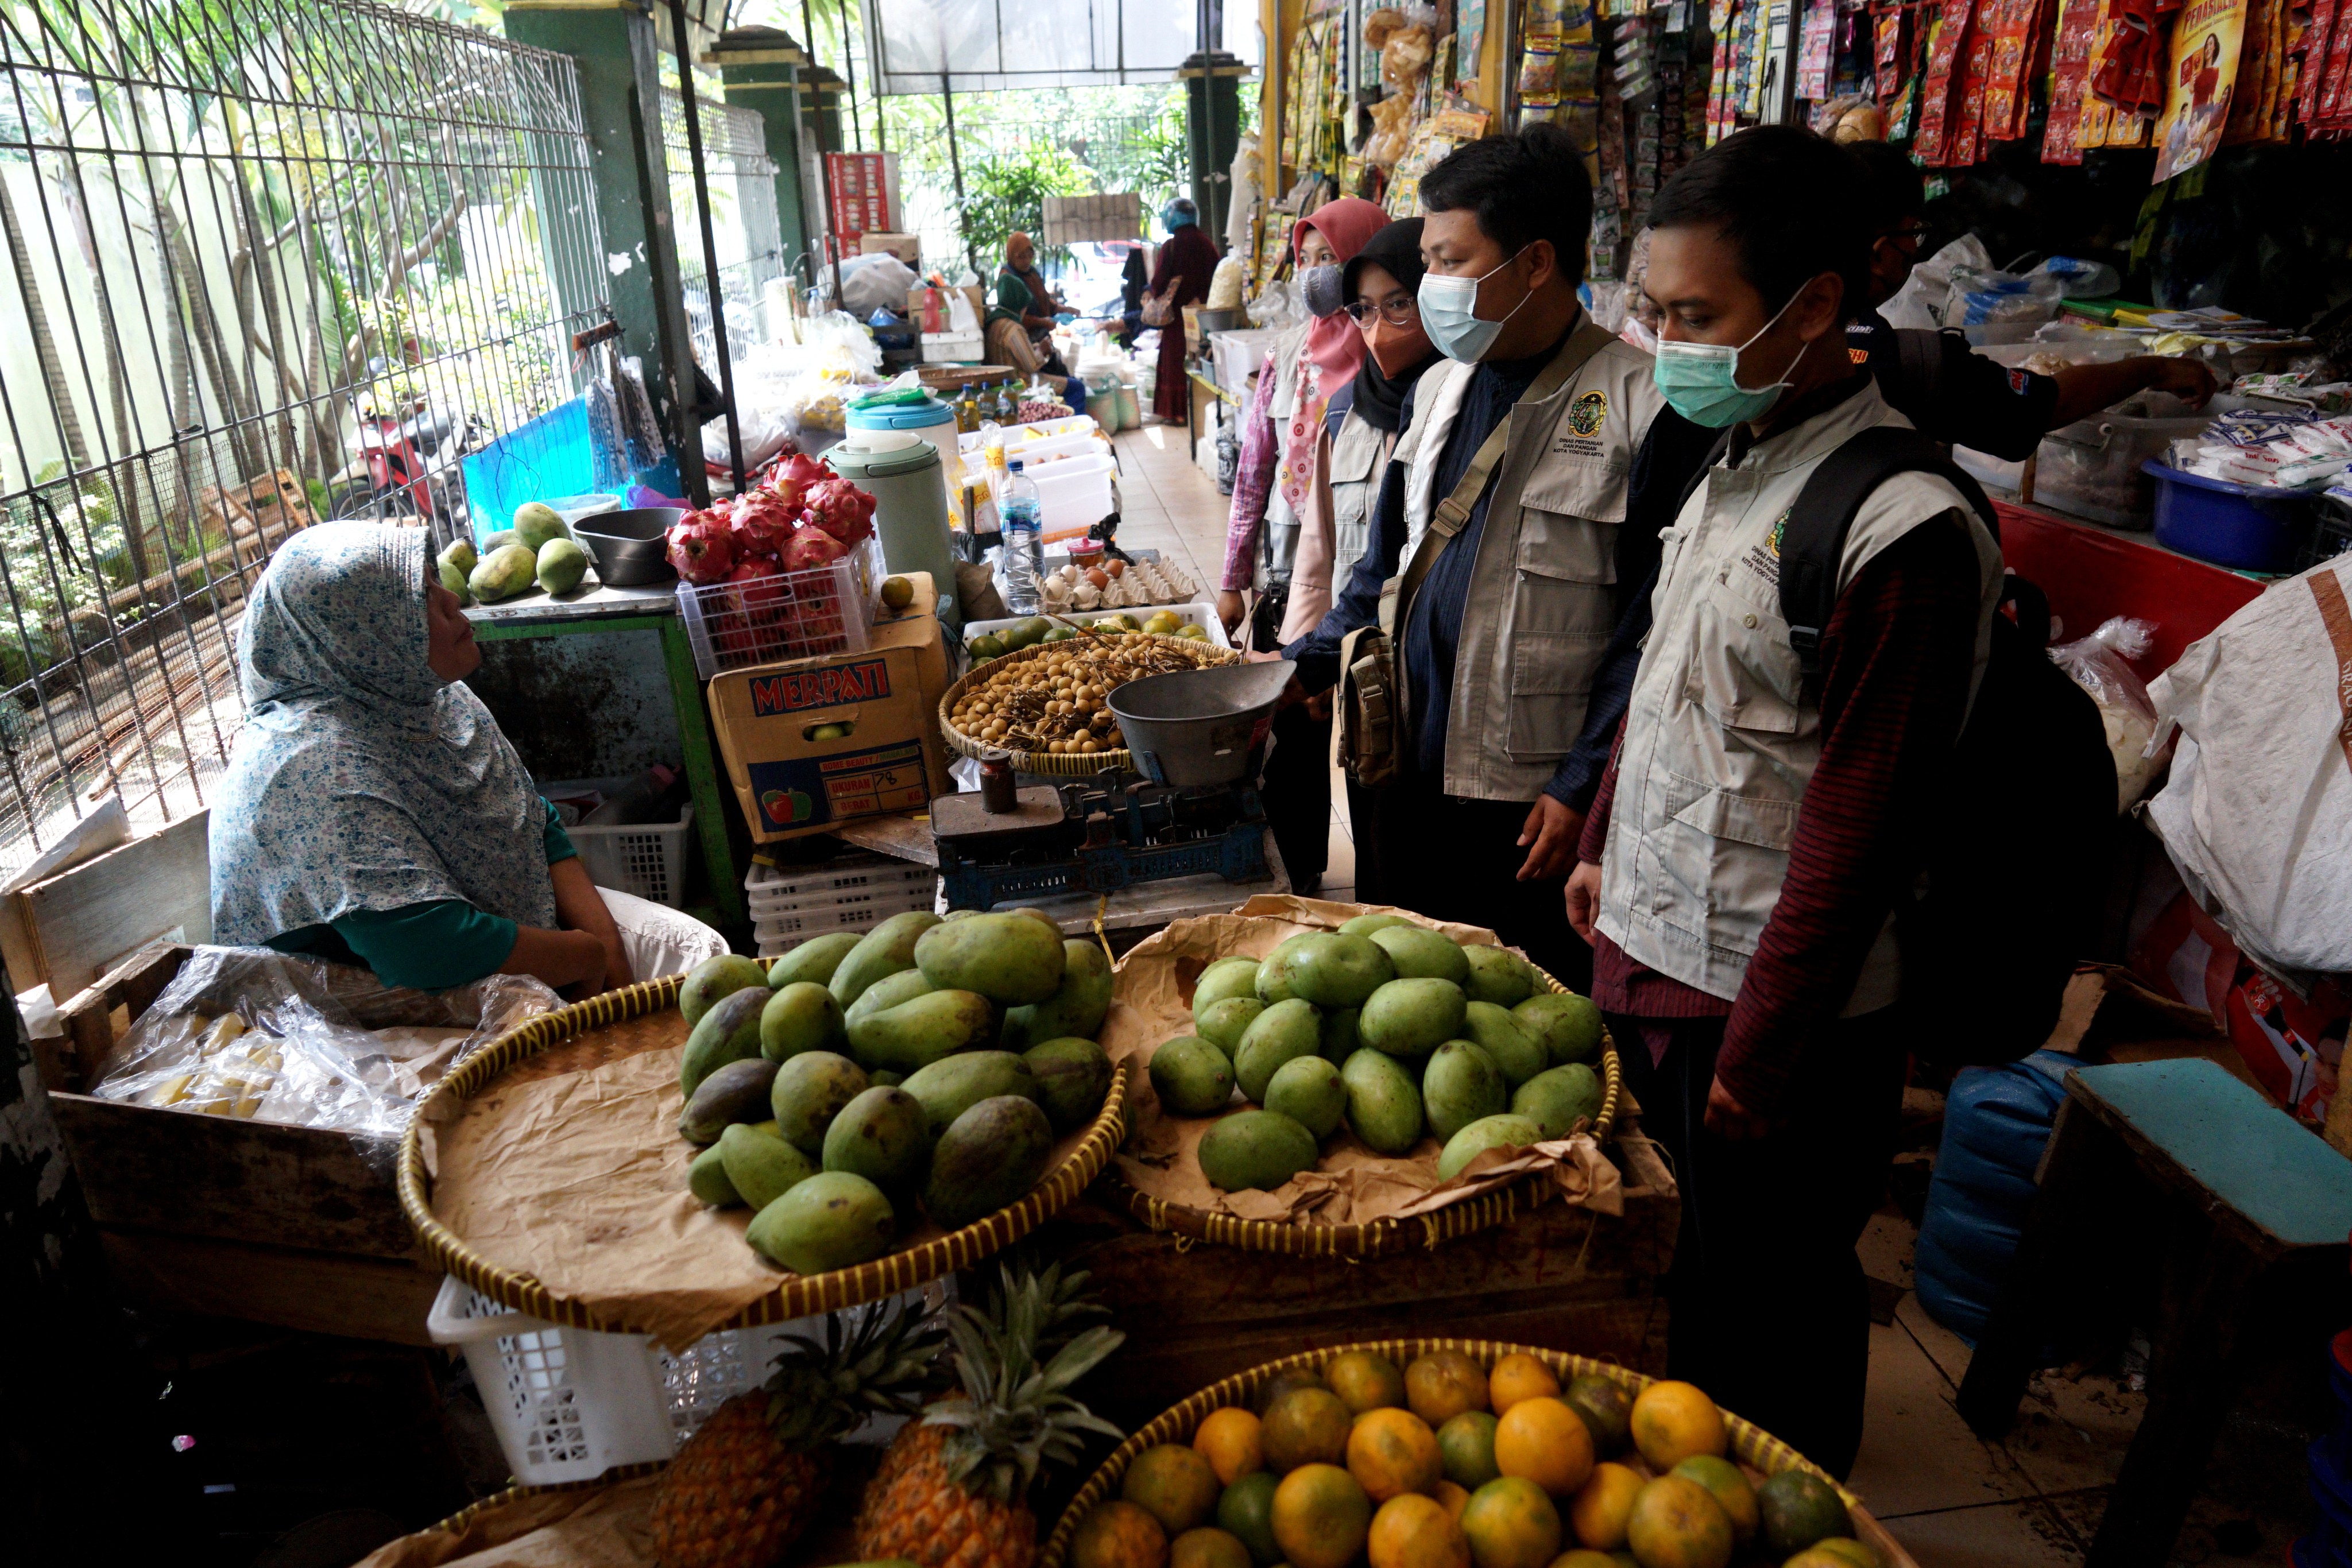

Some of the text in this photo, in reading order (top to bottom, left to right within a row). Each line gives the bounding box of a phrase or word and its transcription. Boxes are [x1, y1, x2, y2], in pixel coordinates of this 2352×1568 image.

[1569, 450, 1604, 458] YOGYAKARTA
[1751, 545, 1767, 559] DINAS
[1741, 556, 1754, 569] KOTA
[1751, 555, 1765, 566] DAN
[753, 663, 888, 714] MERPATI
[823, 760, 844, 771] ROME
[846, 755, 873, 767] BEAUTY
[831, 778, 871, 793] UKURAN
[875, 772, 898, 786] 78
[840, 799, 871, 811] BERAT
[2254, 991, 2267, 1007] ABC
